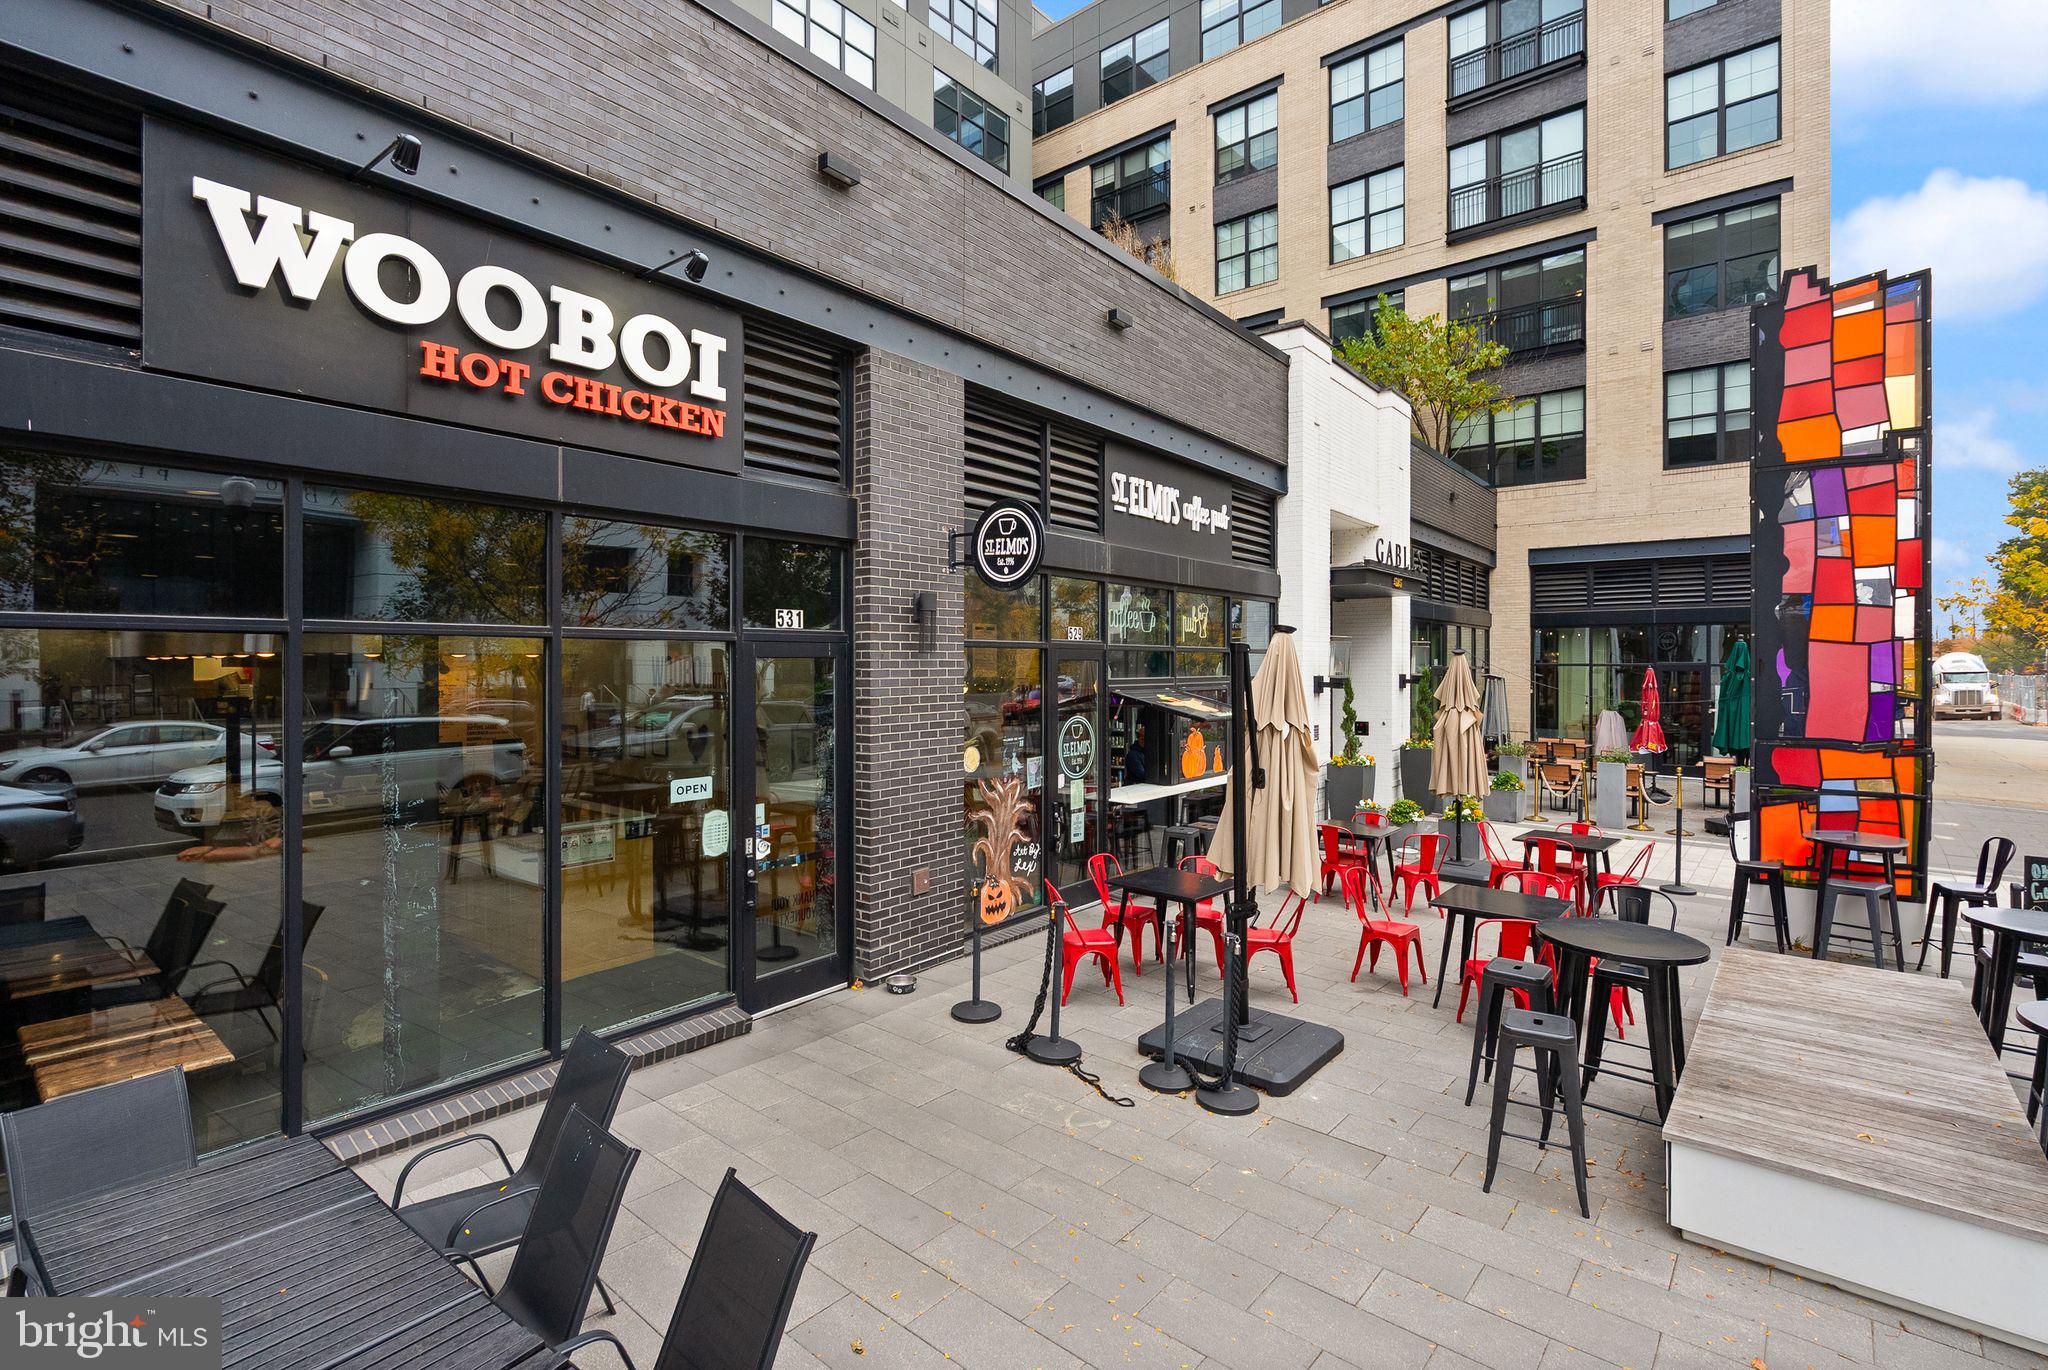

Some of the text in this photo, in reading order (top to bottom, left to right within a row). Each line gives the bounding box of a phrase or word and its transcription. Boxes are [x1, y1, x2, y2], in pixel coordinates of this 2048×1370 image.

[192, 176, 727, 402] WOOBOI
[419, 340, 726, 438] HOT CHICKEN
[1128, 476, 1180, 525] ELMO'S
[1182, 495, 1210, 532] coffee
[1210, 504, 1230, 535] pub
[995, 537, 1029, 555] ELMO'S
[776, 610, 803, 628] 531
[1107, 598, 1140, 639] coffee
[1183, 605, 1200, 642] pub
[1068, 627, 1083, 640] 529
[676, 783, 708, 796] OPEN
[1013, 844, 1028, 856] Art
